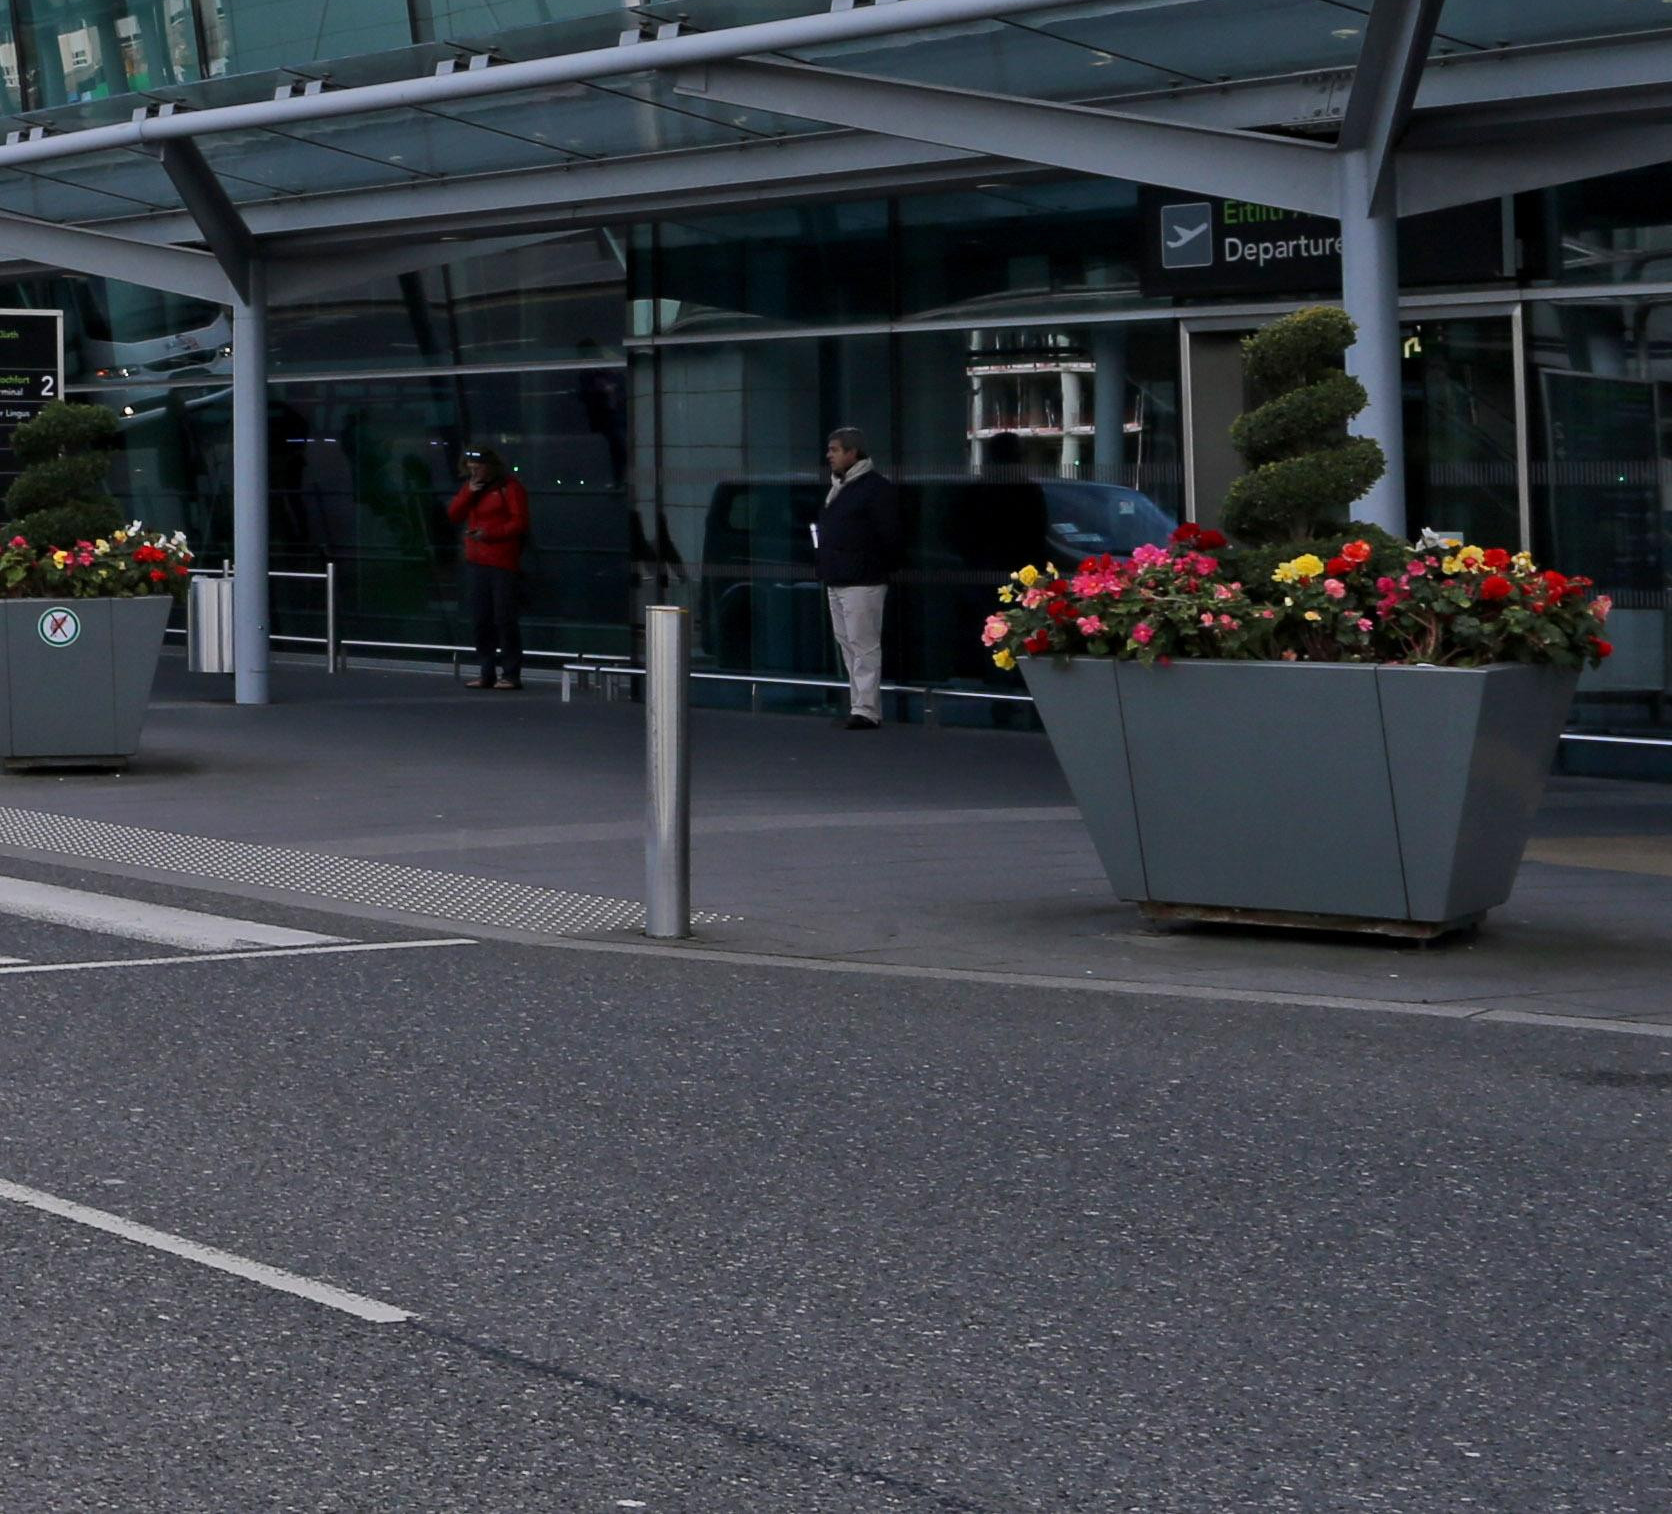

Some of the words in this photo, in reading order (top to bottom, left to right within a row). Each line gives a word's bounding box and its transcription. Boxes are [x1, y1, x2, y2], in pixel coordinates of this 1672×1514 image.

[1224, 235, 1343, 267] Departure
[40, 375, 54, 397] 2
[6, 409, 30, 419] Lingus
